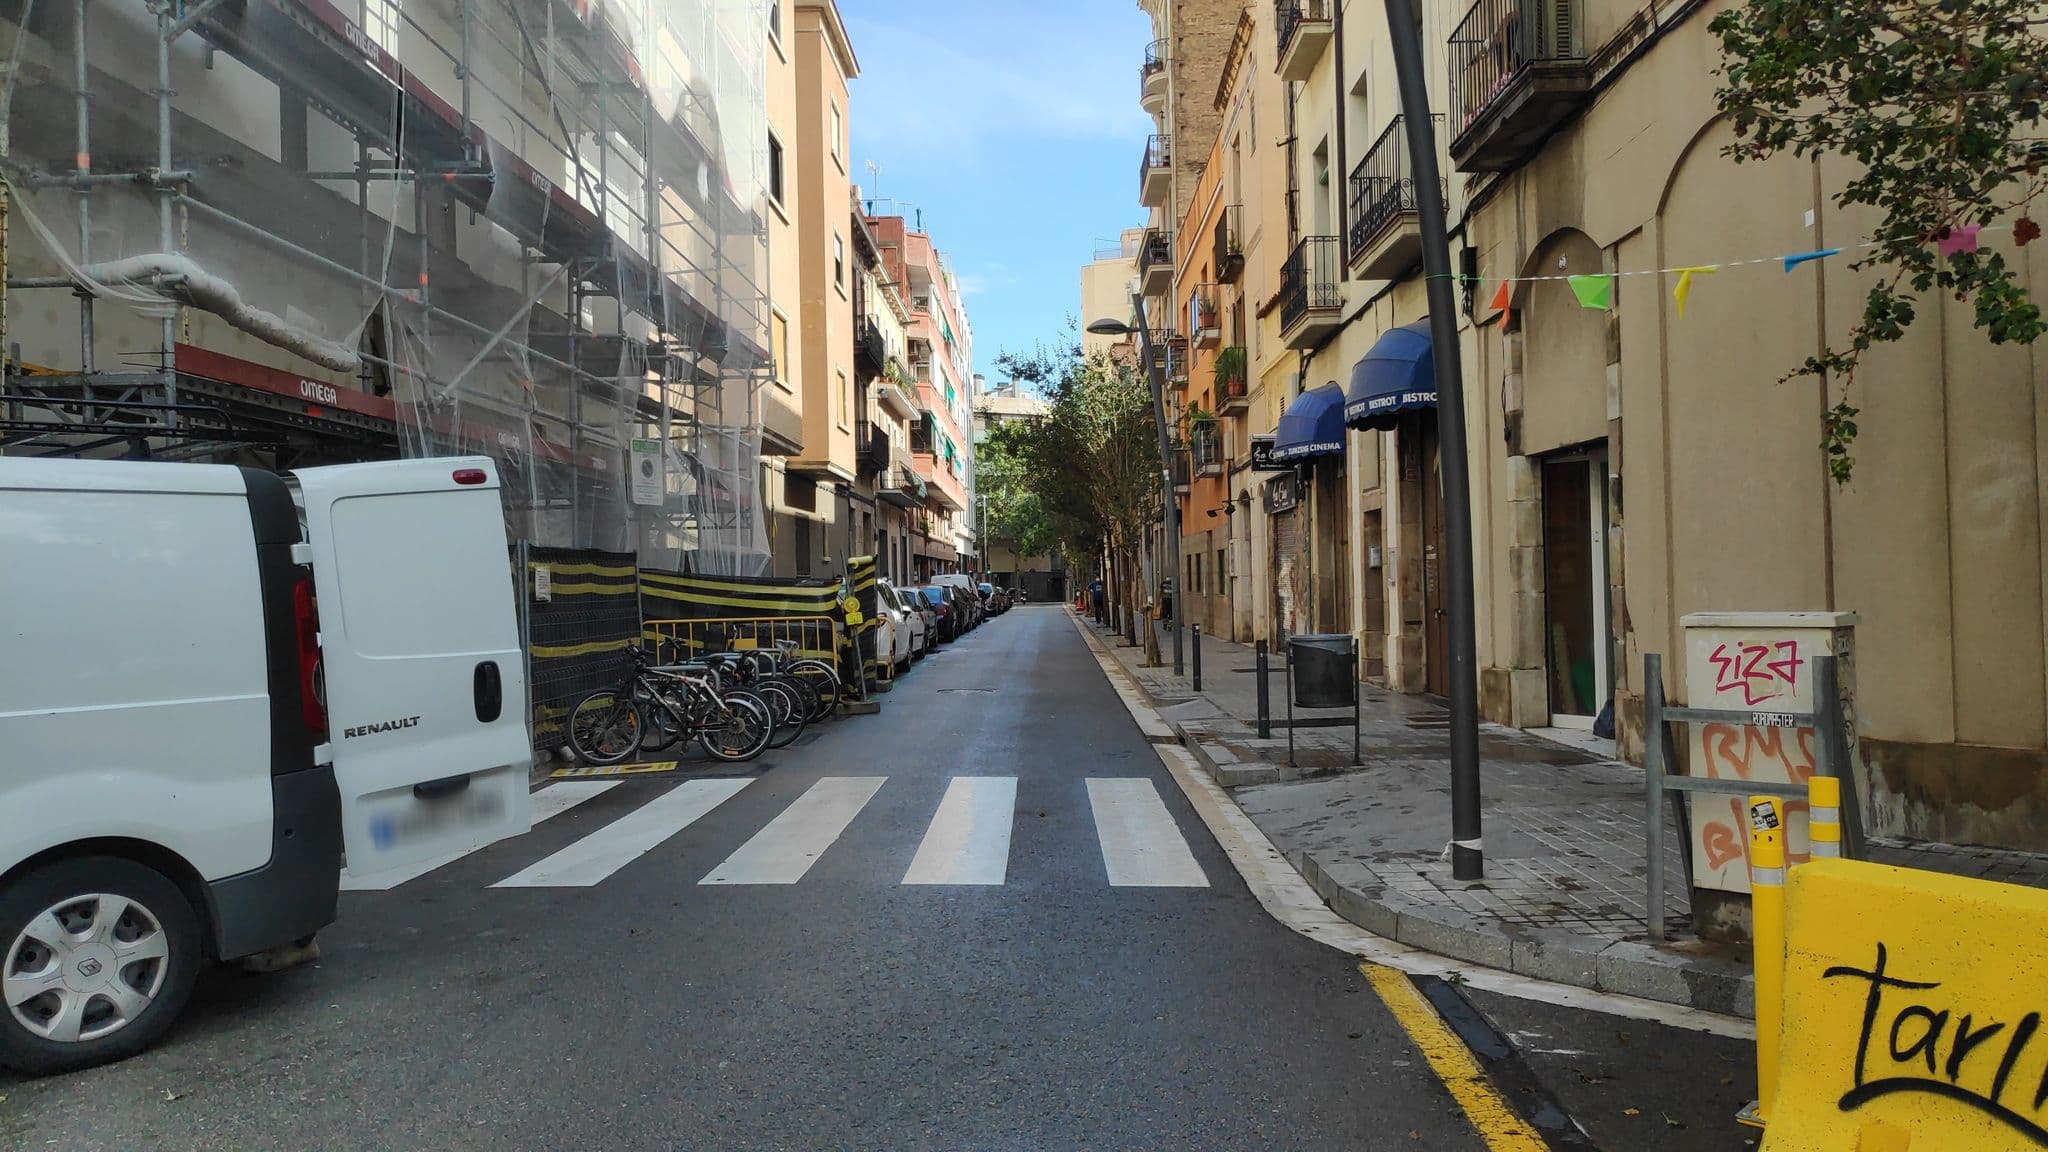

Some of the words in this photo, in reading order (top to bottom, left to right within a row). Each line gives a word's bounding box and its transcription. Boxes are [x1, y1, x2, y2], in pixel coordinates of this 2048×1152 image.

[345, 21, 379, 62] OMEGA
[300, 380, 337, 405] OMEGA
[1368, 396, 1397, 410] BISTROT
[1309, 442, 1341, 452] CINEMA
[343, 715, 421, 739] RENAULT
